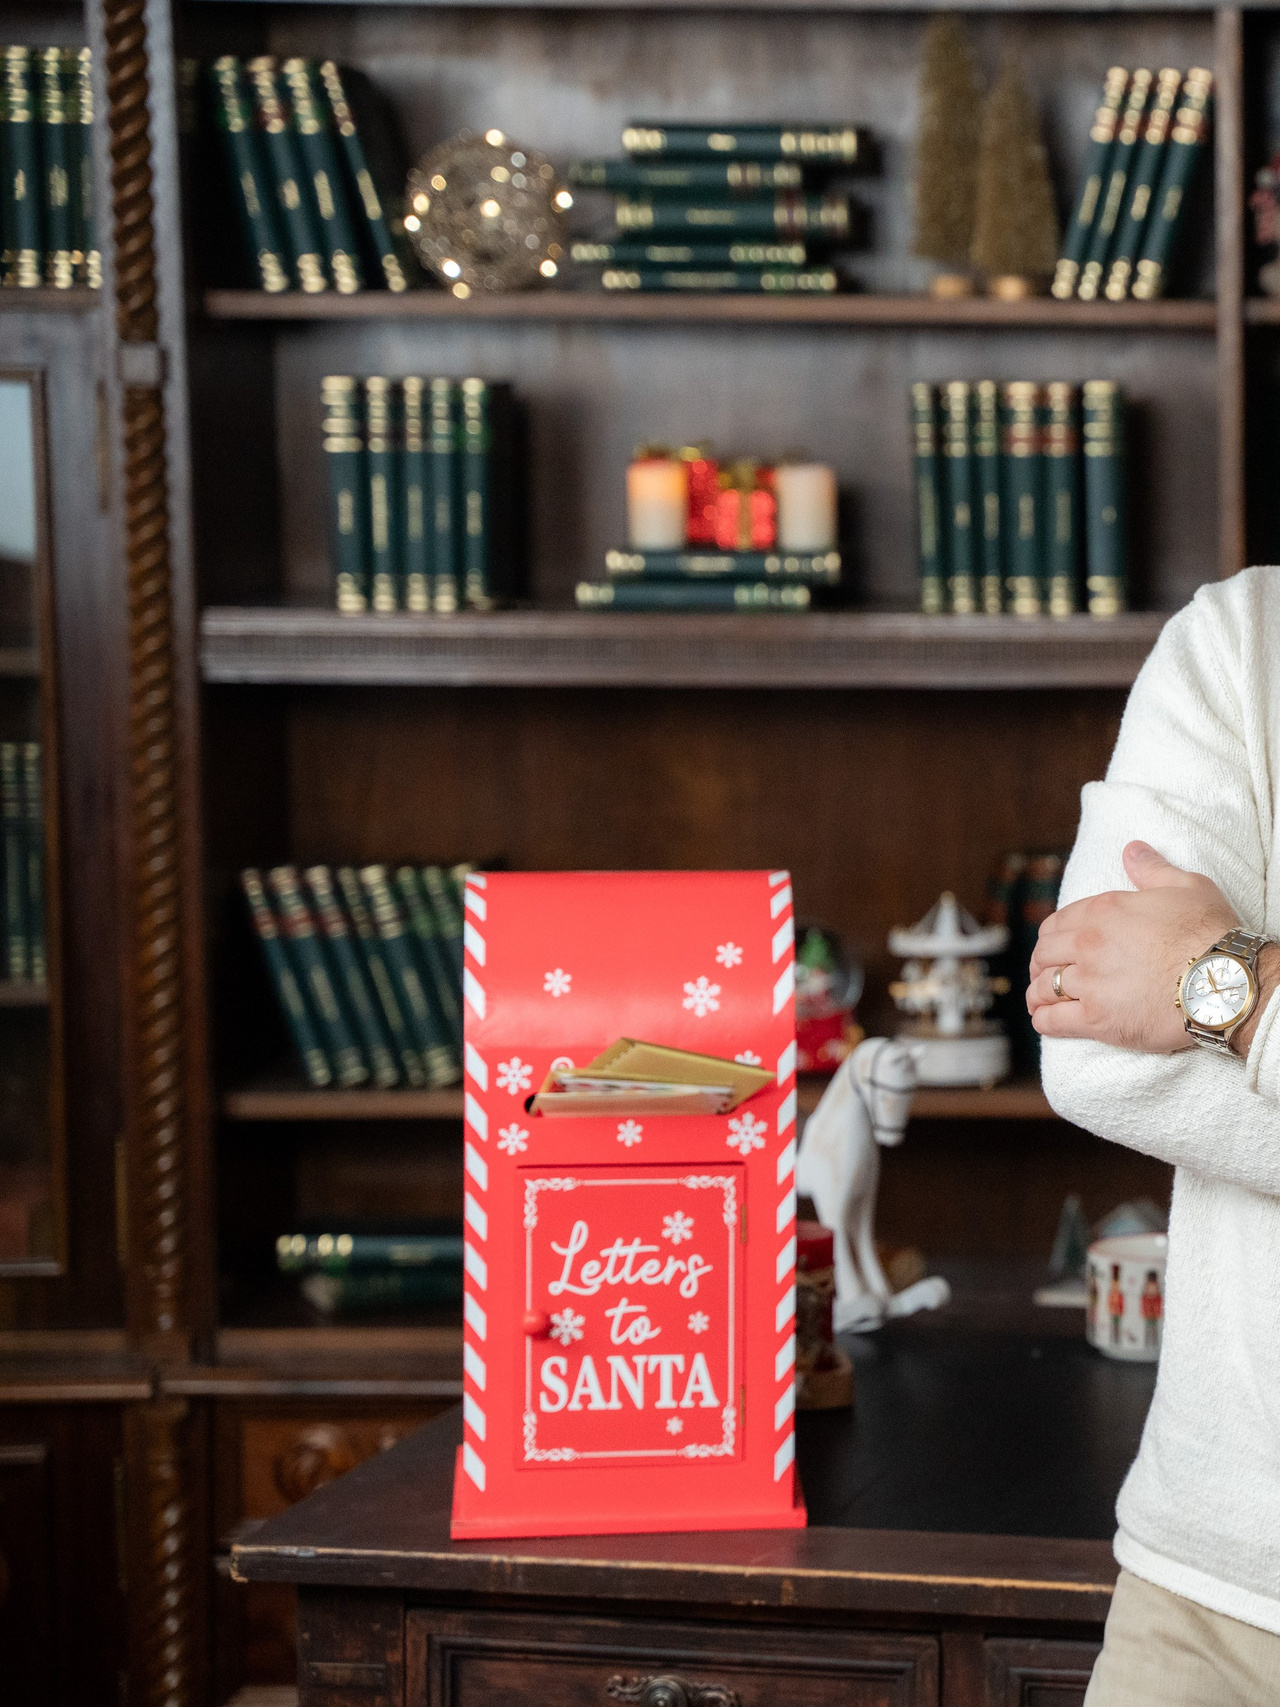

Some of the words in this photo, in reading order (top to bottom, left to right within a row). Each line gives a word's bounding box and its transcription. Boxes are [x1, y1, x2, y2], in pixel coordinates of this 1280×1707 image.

[548, 1220, 713, 1298] Letters
[604, 1297, 661, 1345] to
[539, 1353, 720, 1413] SANTA
